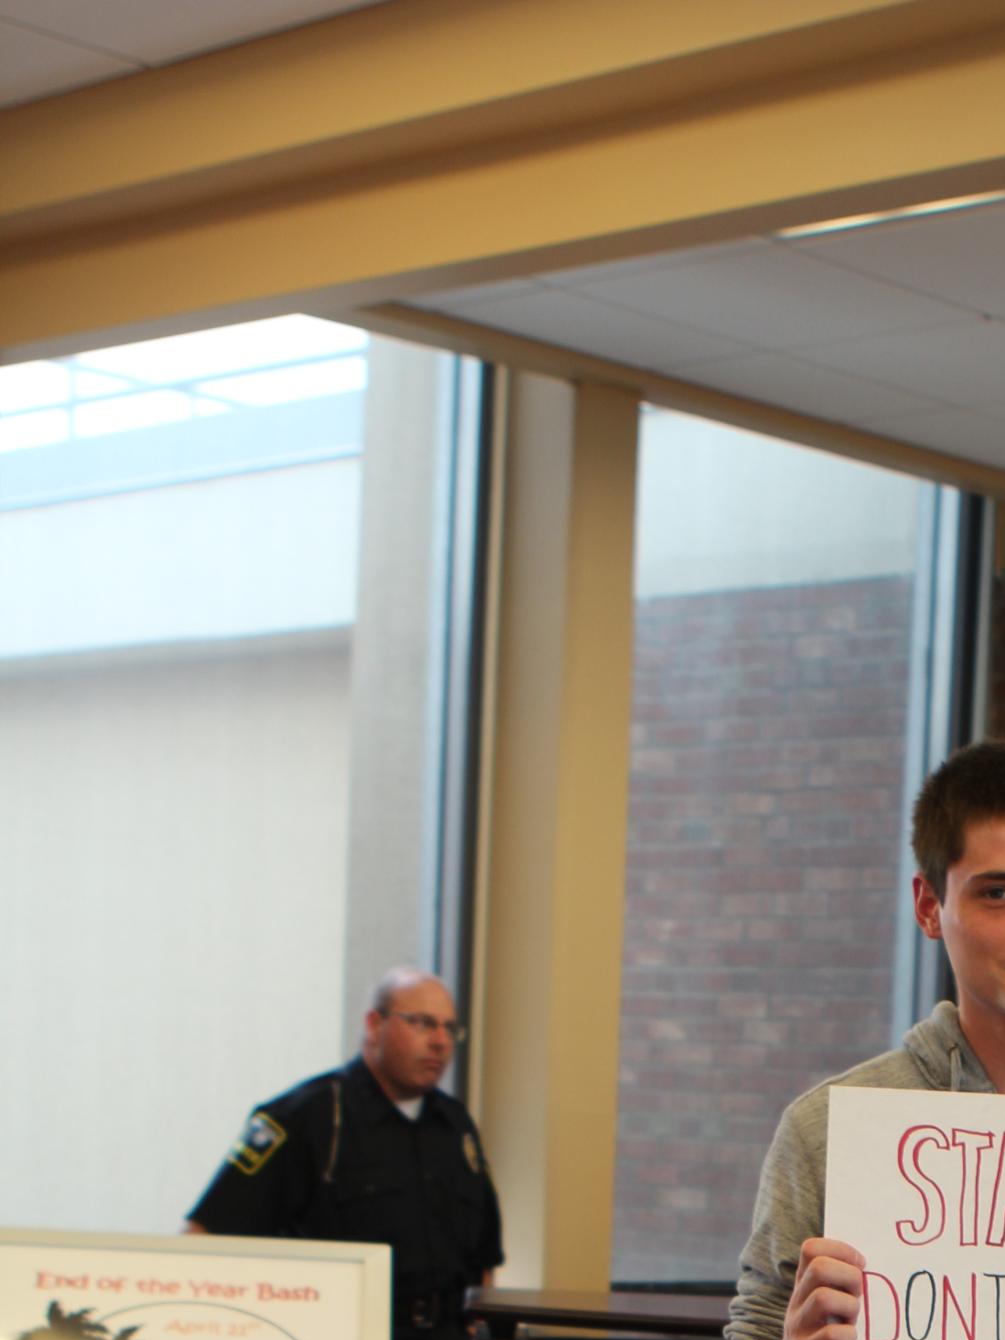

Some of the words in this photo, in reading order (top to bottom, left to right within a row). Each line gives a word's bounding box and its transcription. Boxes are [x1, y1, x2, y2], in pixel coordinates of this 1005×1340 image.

[35, 1271, 88, 1290] End
[96, 1275, 125, 1293] of
[136, 1278, 180, 1295] the
[189, 1279, 247, 1298] Year
[256, 1282, 320, 1302] Bash
[165, 1318, 221, 1337] April
